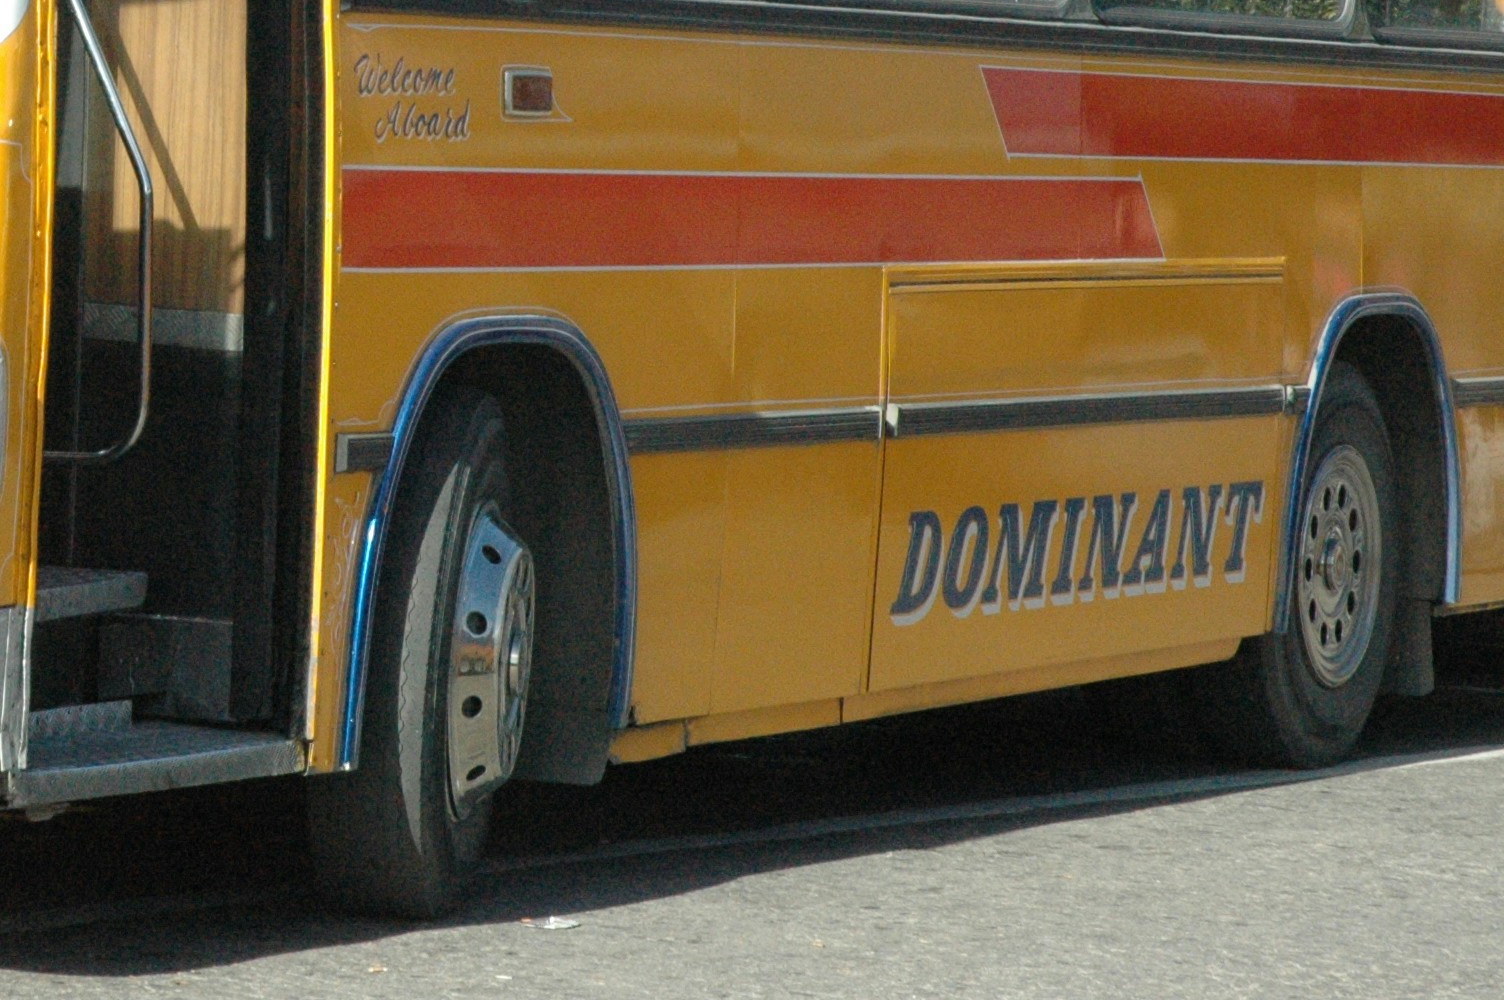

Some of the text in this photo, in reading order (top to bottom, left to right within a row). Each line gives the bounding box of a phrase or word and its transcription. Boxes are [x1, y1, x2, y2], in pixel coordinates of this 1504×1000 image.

[354, 52, 456, 97] Welcome
[374, 99, 471, 144] Aboard
[890, 480, 1264, 626] DOMINANT
